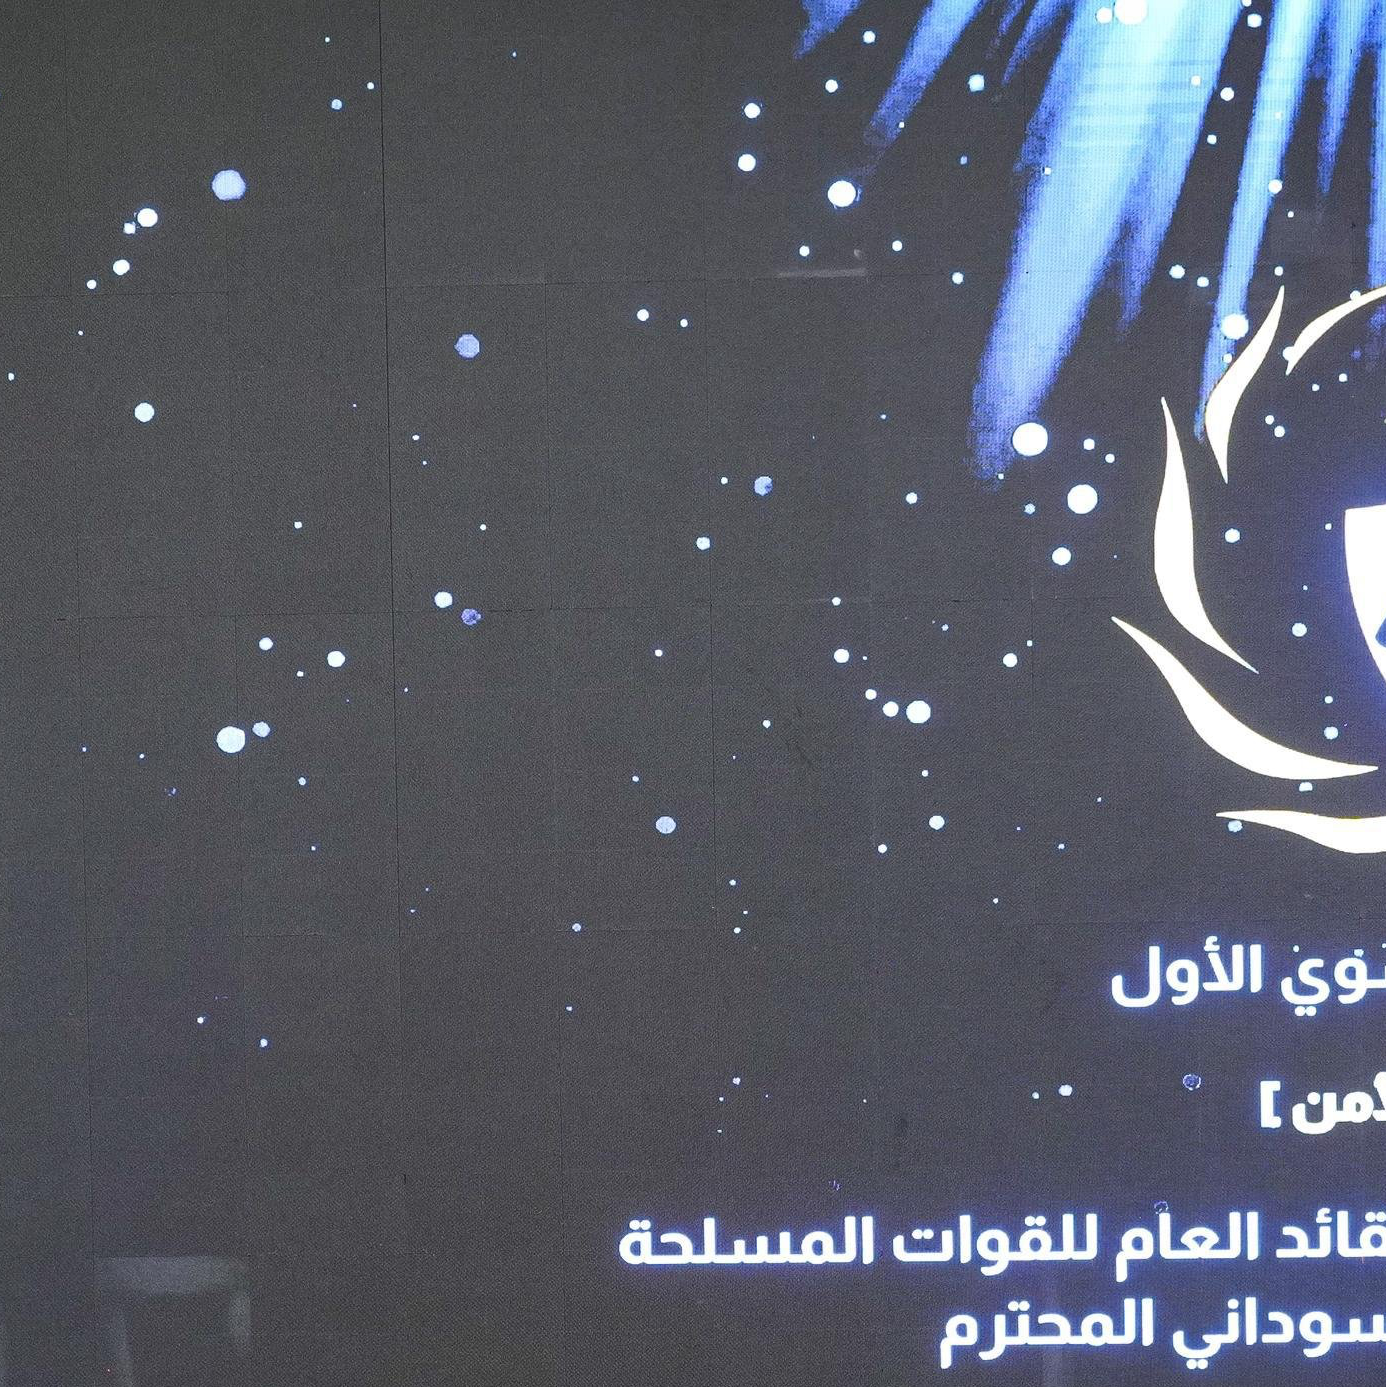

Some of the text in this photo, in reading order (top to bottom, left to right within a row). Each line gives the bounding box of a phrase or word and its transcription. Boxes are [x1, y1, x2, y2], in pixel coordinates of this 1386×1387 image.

[1110, 934, 1265, 1009] الأول
[617, 1214, 876, 1266] المسلحة
[892, 1212, 1100, 1278] للقوات
[1115, 1211, 1260, 1284] العام
[939, 1299, 1155, 1370] المحترم
